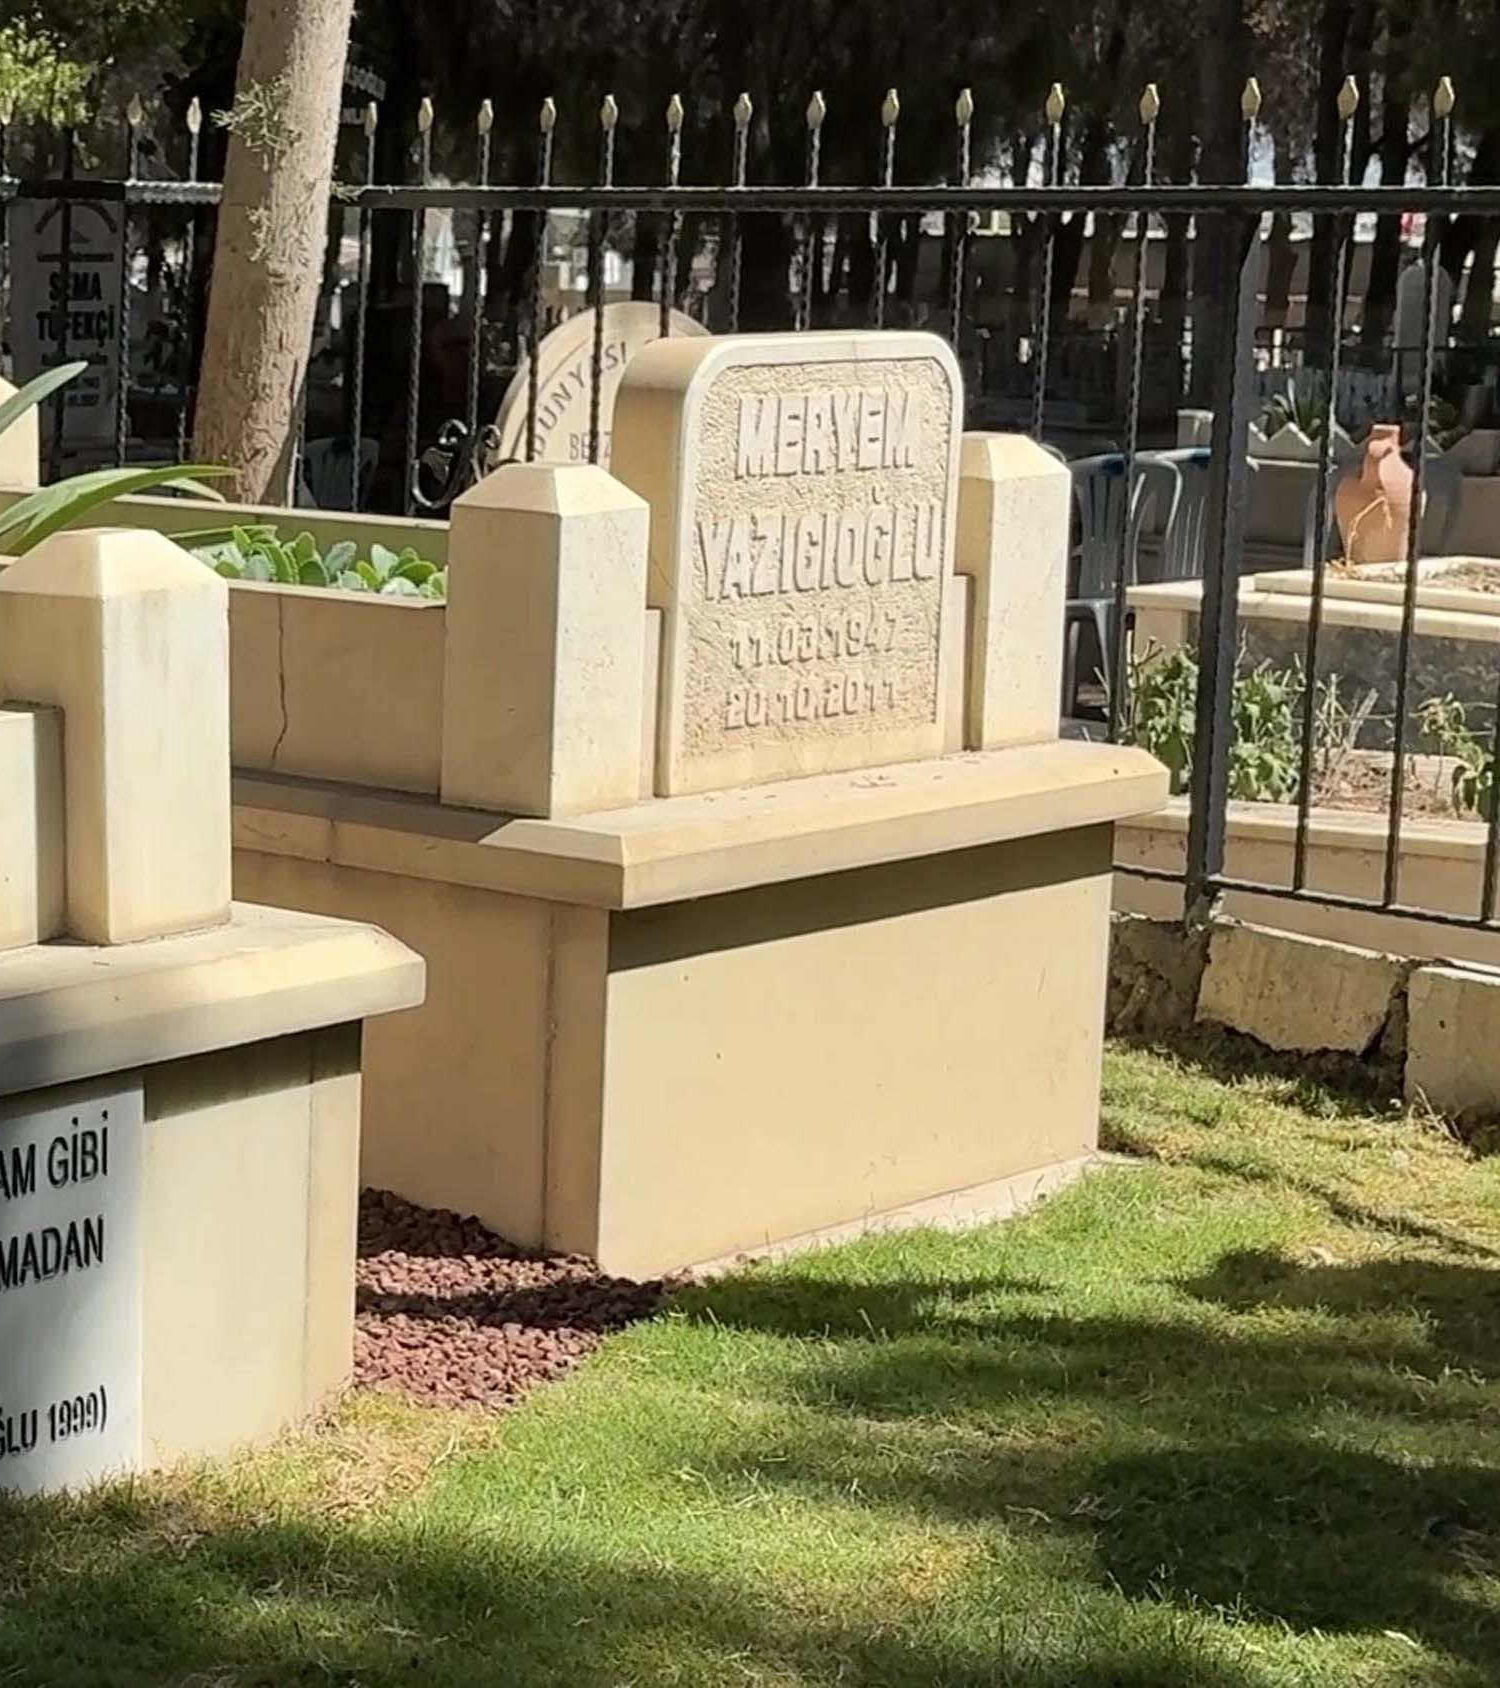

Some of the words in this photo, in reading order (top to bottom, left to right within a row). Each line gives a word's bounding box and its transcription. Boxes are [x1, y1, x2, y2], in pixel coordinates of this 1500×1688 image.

[735, 388, 920, 480] MERYEM
[698, 486, 942, 602] YAZICIOĞLU
[47, 1109, 108, 1189] GİBİ
[47, 1384, 108, 1443] 1999)
